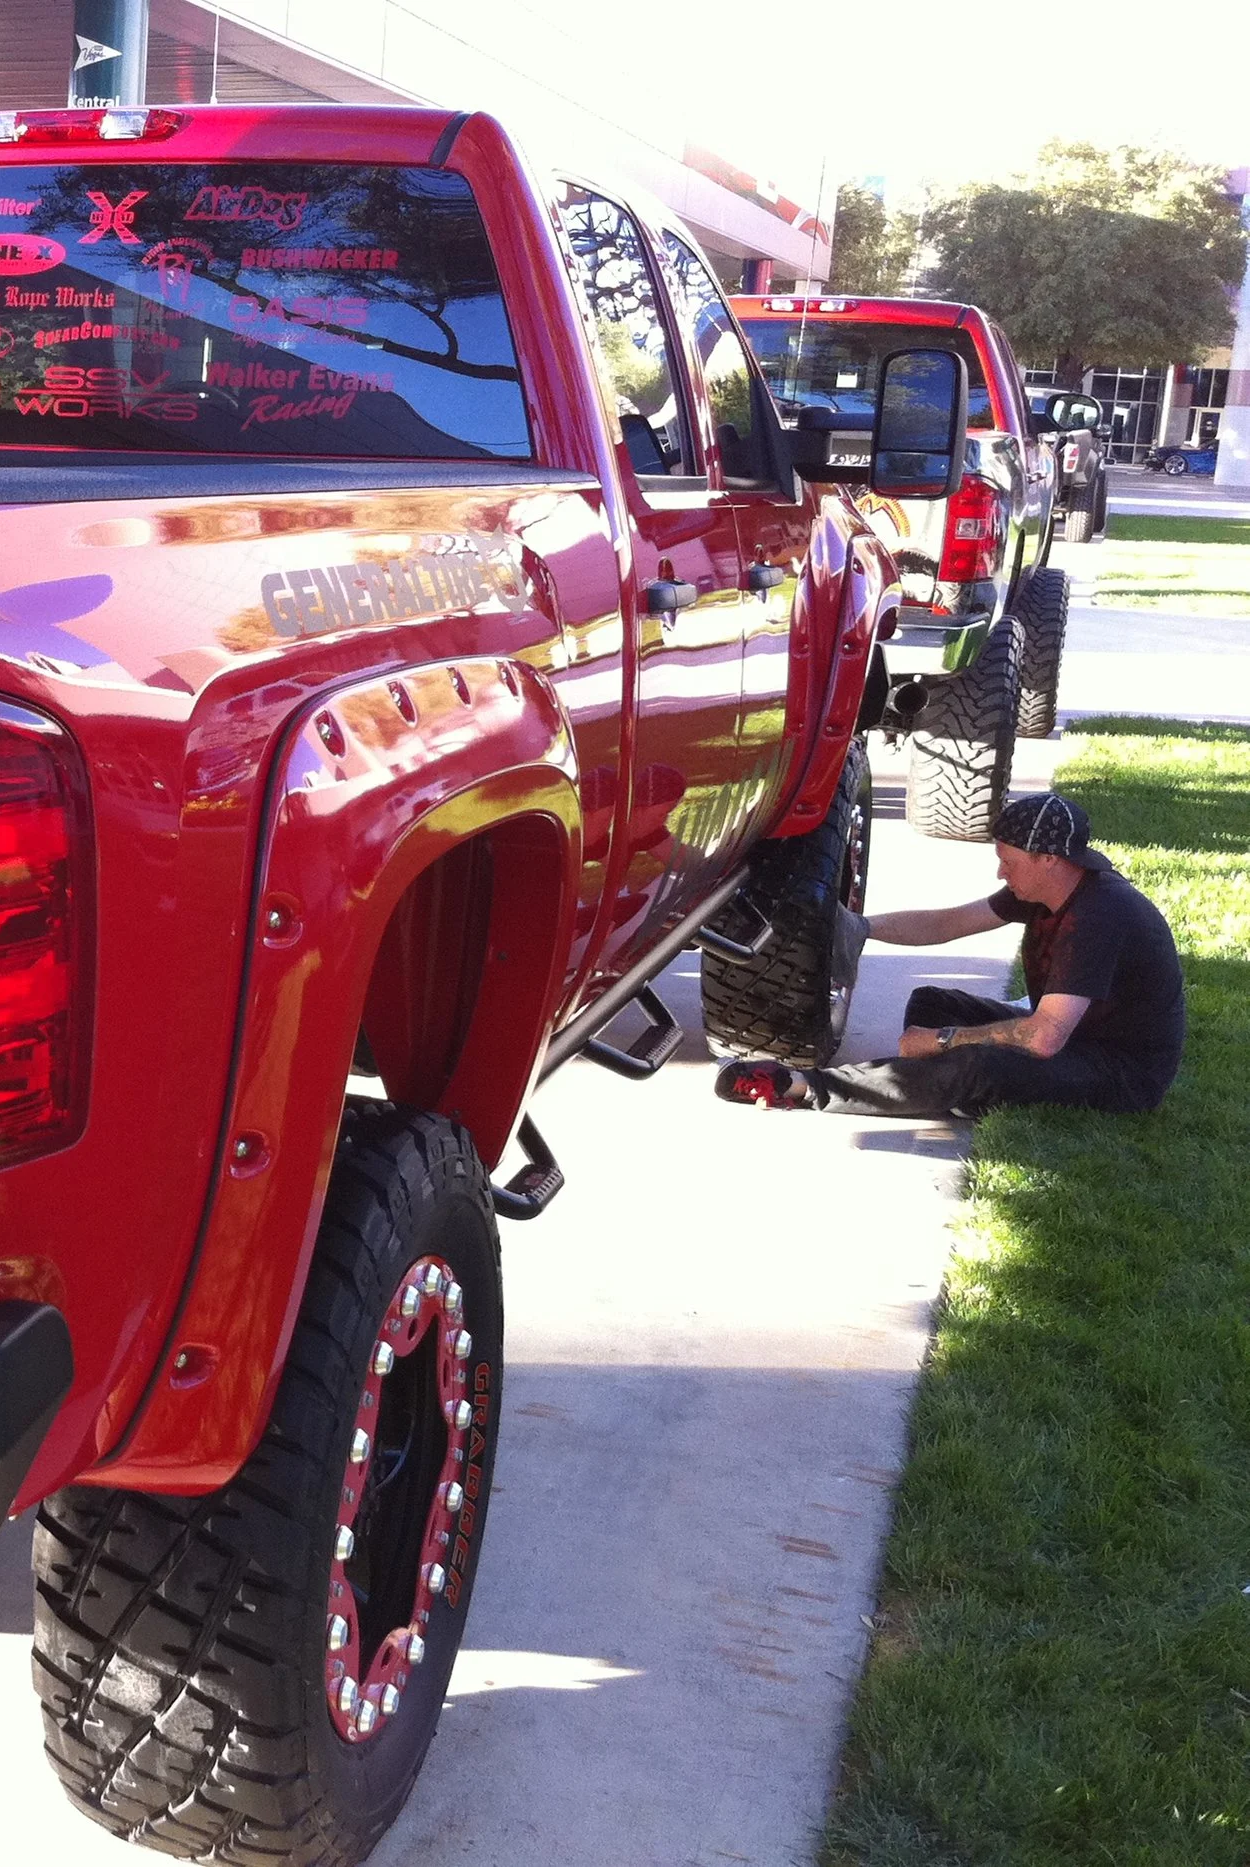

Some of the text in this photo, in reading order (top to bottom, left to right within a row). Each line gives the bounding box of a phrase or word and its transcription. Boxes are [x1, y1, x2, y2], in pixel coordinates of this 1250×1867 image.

[240, 248, 400, 269] BUSHWACKER
[4, 285, 50, 312] Rope
[55, 285, 117, 309] Works
[228, 295, 370, 326] OASIS
[43, 366, 172, 392] SSV
[206, 361, 394, 392] Walker Evans
[12, 396, 199, 420] WORKS
[239, 391, 357, 432] Racing
[443, 1361, 493, 1611] GRABBER
